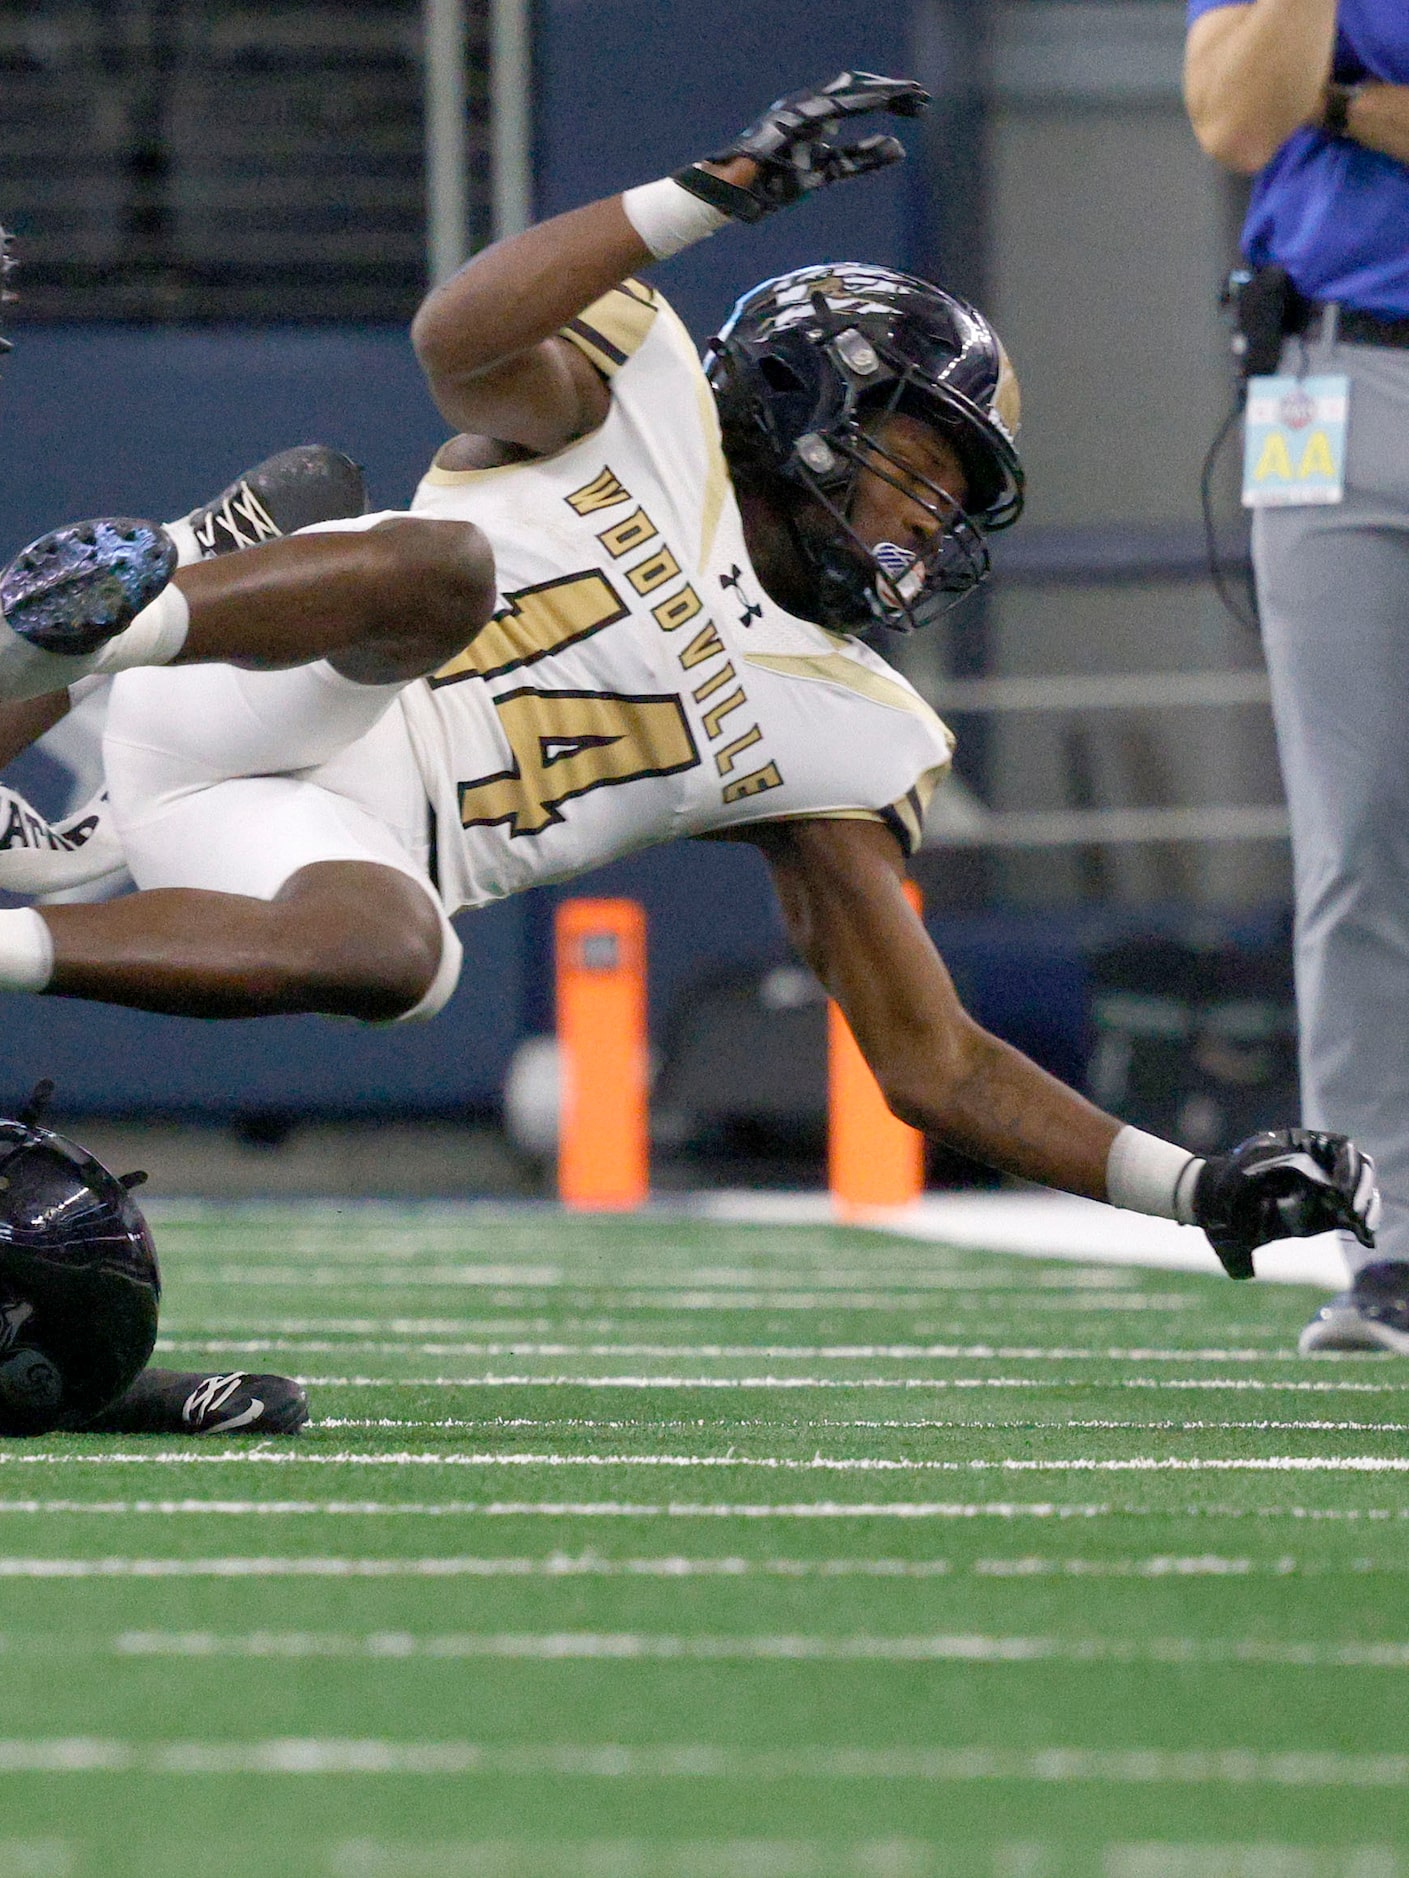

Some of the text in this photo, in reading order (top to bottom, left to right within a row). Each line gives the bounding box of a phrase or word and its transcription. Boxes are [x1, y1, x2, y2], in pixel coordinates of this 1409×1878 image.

[1254, 431, 1336, 481] AA
[428, 567, 701, 840] 14
[564, 464, 785, 804] WOODVILLE
